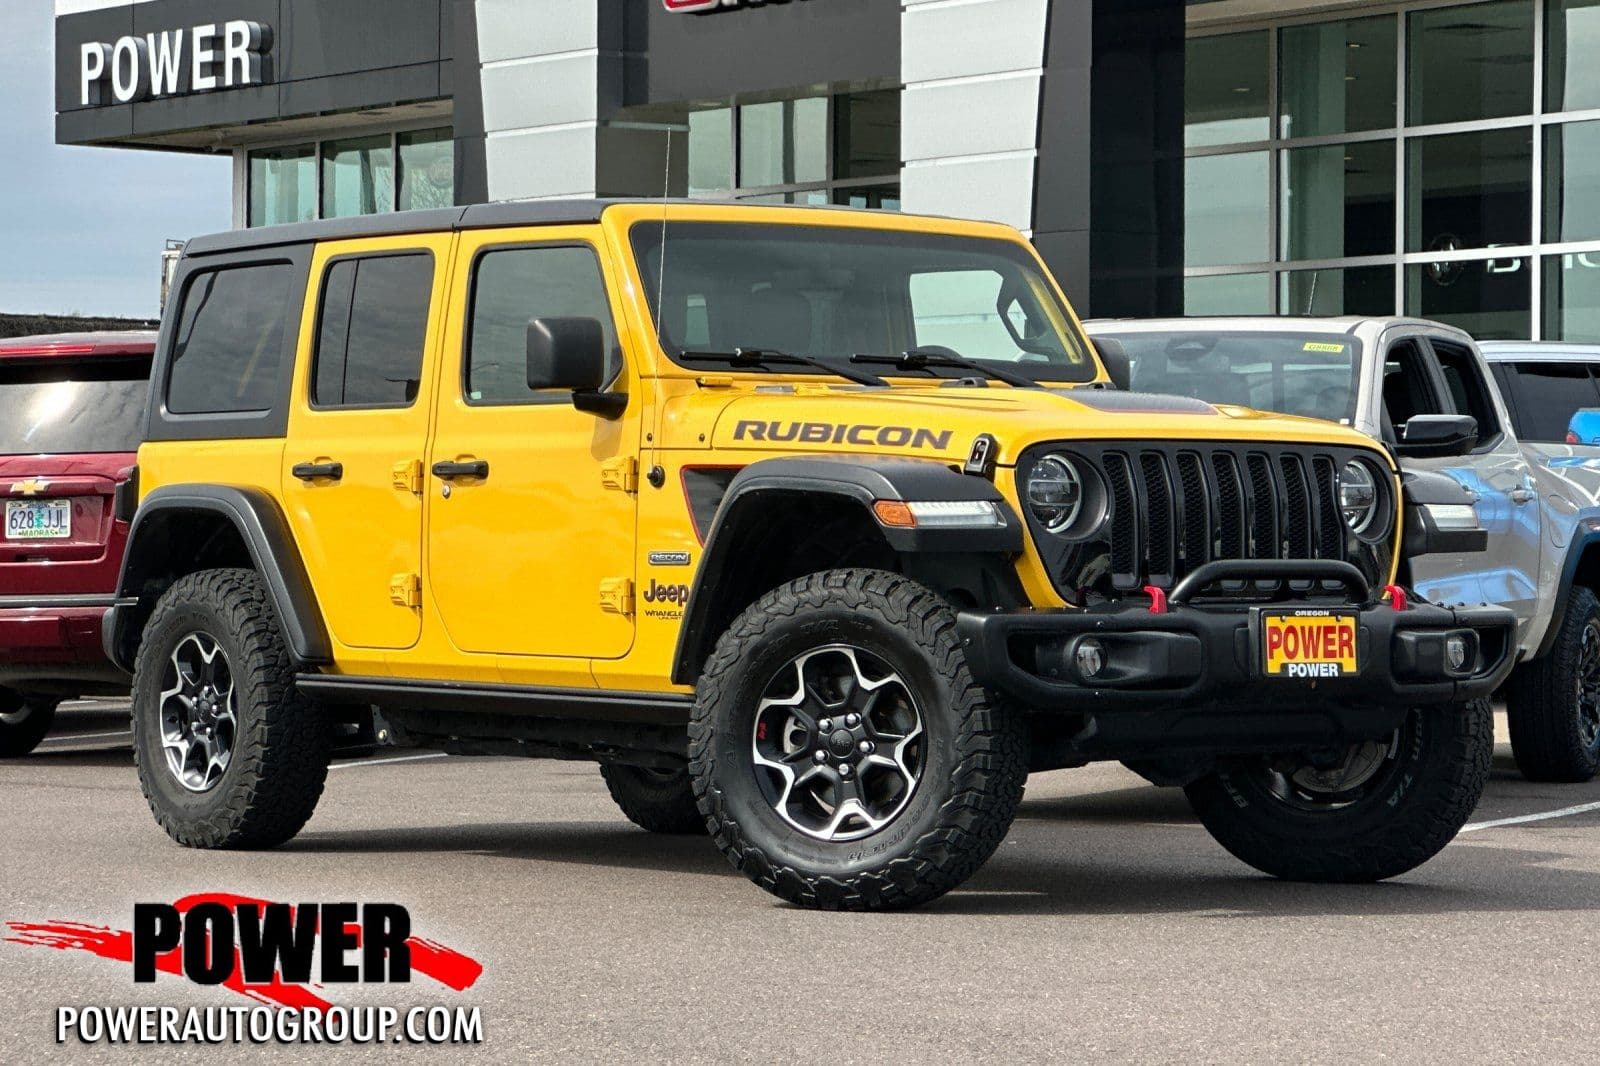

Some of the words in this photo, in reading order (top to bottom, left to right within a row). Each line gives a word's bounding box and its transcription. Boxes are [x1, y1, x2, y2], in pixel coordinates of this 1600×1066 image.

[80, 20, 254, 105] POWER
[734, 420, 953, 449] RUBICON
[10, 510, 34, 529] 628
[44, 509, 67, 528] JJL
[21, 529, 55, 537] MADRAS
[644, 579, 689, 607] Jeep
[1268, 625, 1354, 660] POWER
[1288, 663, 1338, 677] POWER
